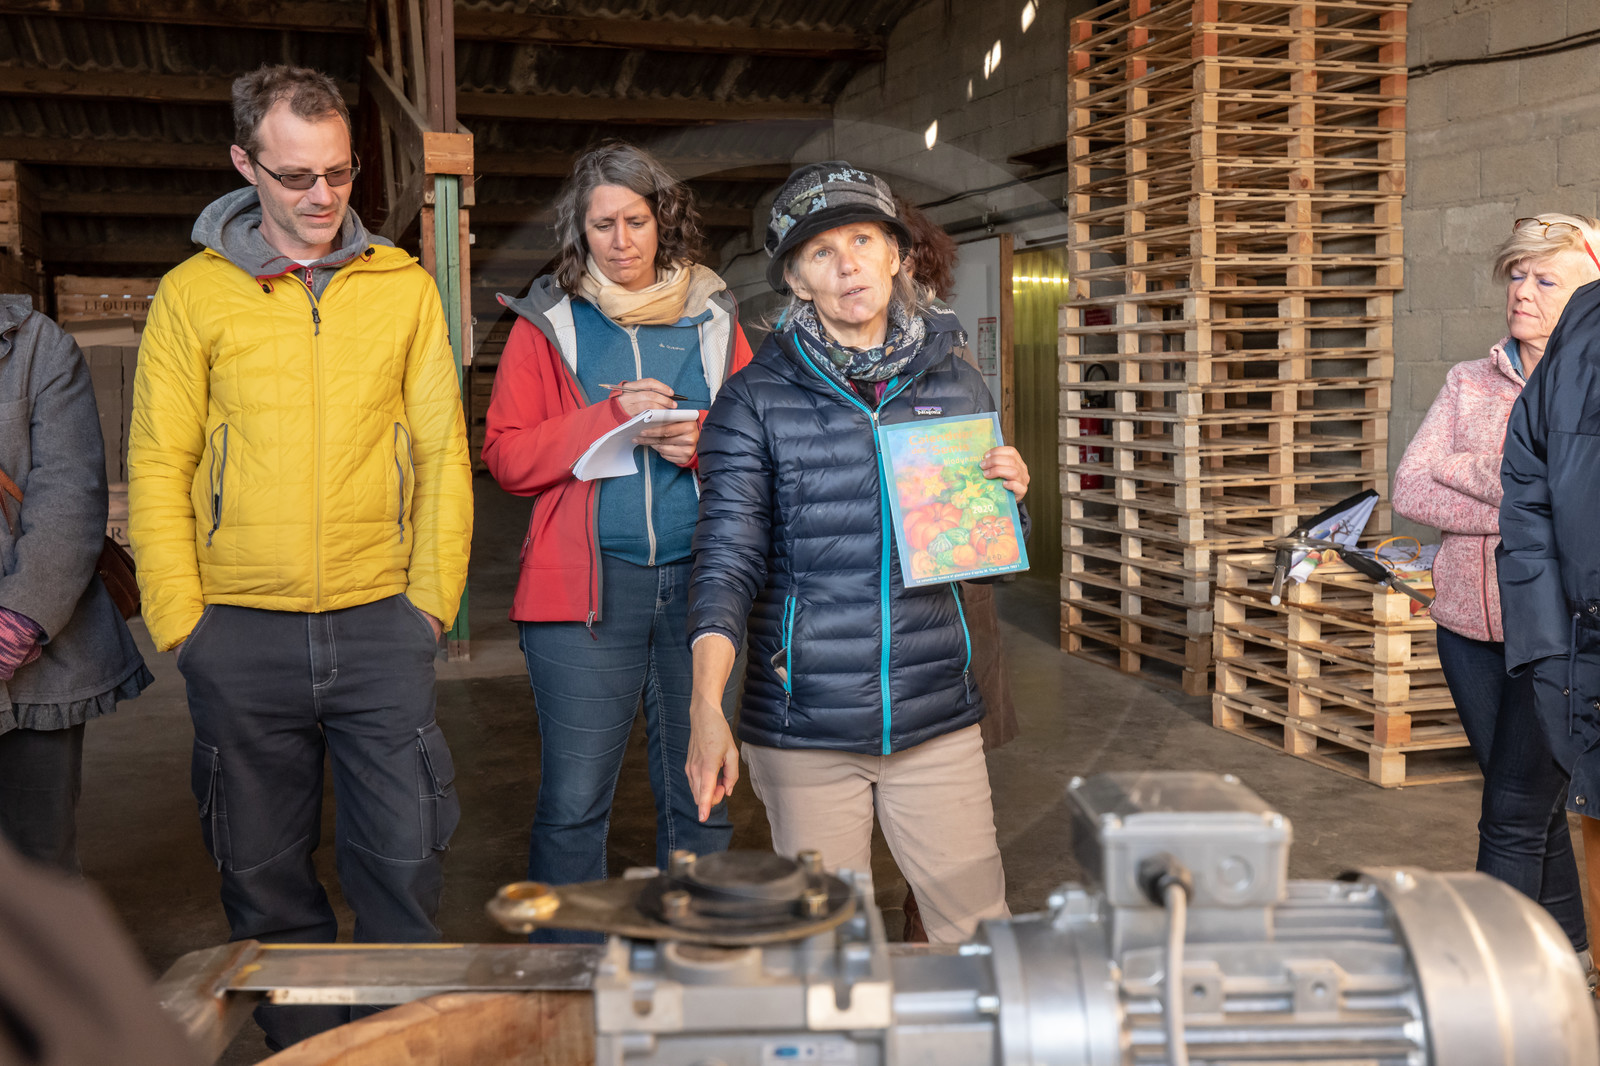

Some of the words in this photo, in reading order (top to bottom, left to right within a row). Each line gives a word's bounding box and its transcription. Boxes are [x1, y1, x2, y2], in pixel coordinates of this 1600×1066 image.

[909, 430, 974, 446] Calendrier
[931, 442, 970, 456] Semis
[972, 504, 994, 514] 2020
